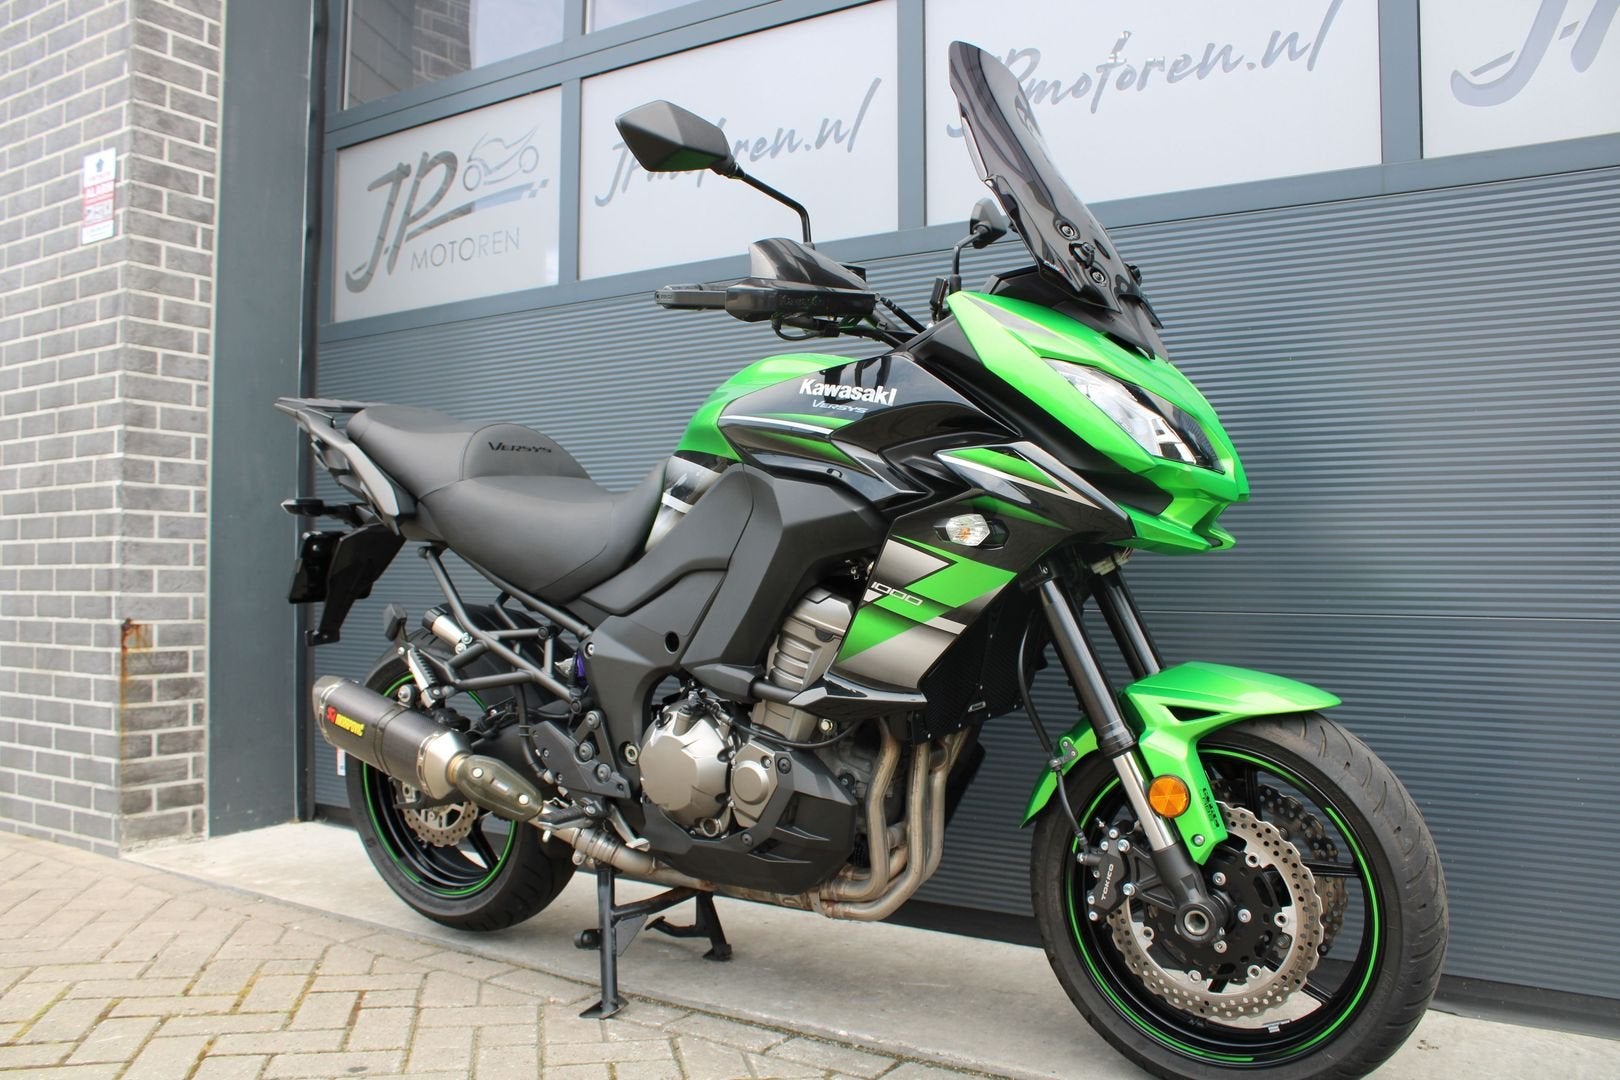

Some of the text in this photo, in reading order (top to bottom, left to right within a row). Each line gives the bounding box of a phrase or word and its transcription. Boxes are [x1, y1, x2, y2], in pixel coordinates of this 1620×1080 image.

[946, 0, 1344, 138] Pmotoren.nl
[410, 227, 520, 271] MOTOREN
[799, 379, 898, 407] Kawasaki
[870, 581, 923, 606] 1000
[1101, 863, 1115, 901] TOKICO
